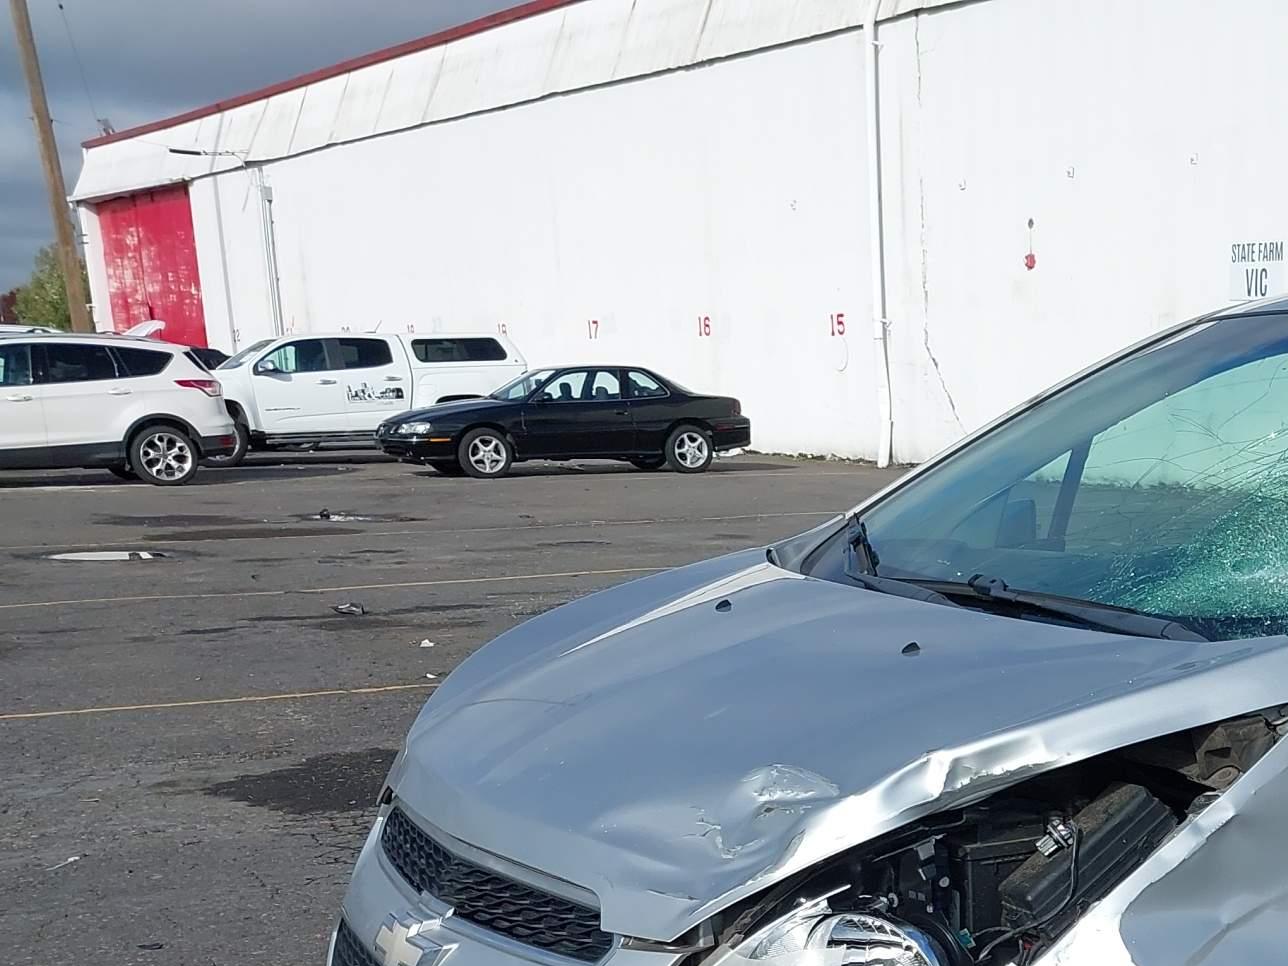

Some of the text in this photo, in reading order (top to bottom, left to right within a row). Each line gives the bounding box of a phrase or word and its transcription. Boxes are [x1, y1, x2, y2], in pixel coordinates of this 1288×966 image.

[1231, 241, 1284, 263] STATE FARM
[1245, 267, 1268, 297] VIC
[587, 320, 599, 340] 17
[697, 316, 712, 337] 16
[830, 313, 846, 337] 15
